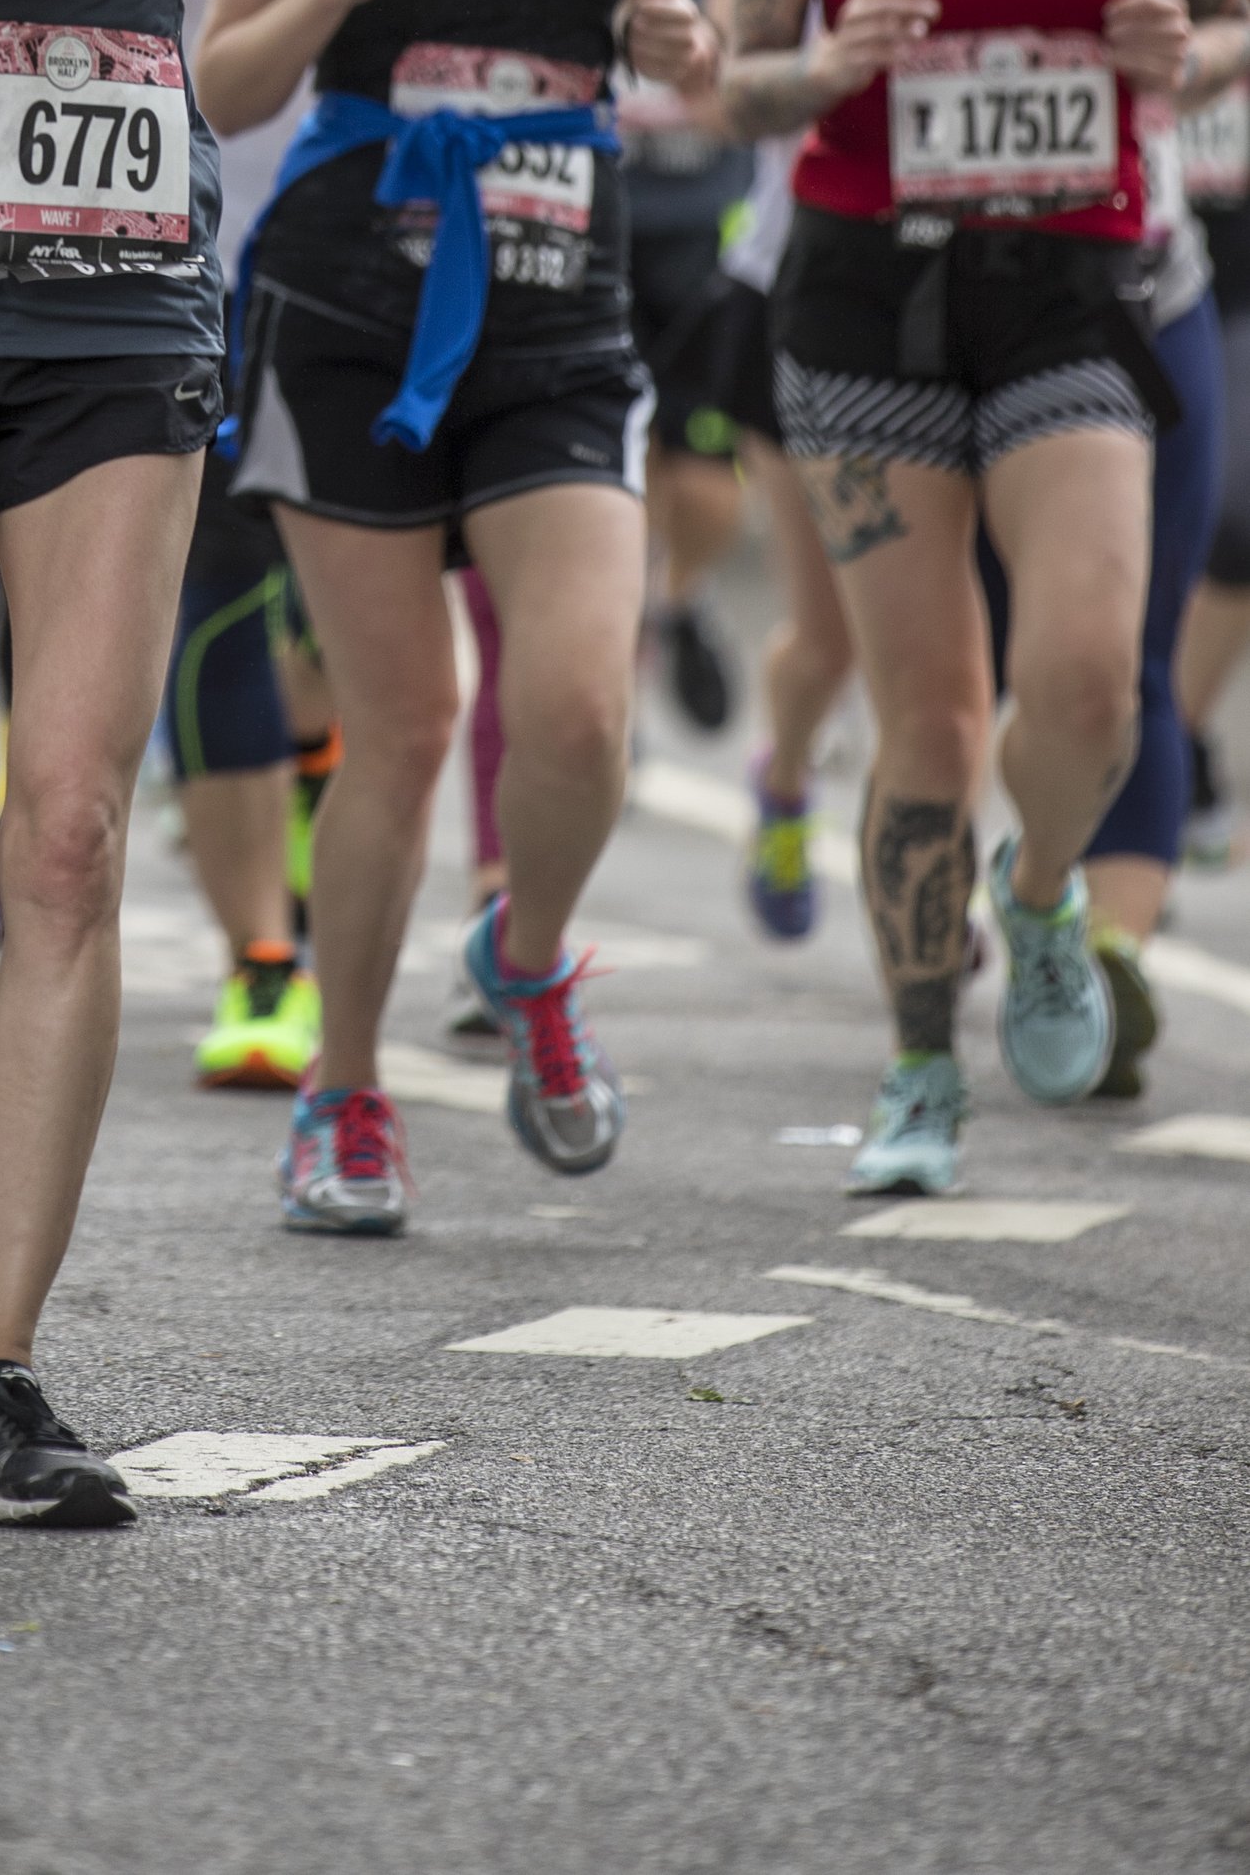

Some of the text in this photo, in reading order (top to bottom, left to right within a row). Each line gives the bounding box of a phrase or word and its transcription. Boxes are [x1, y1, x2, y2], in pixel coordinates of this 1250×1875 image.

[48, 55, 90, 69] BROOKLYN
[960, 84, 1096, 160] 17512
[18, 99, 161, 193] 6779
[40, 208, 73, 227] WAVE
